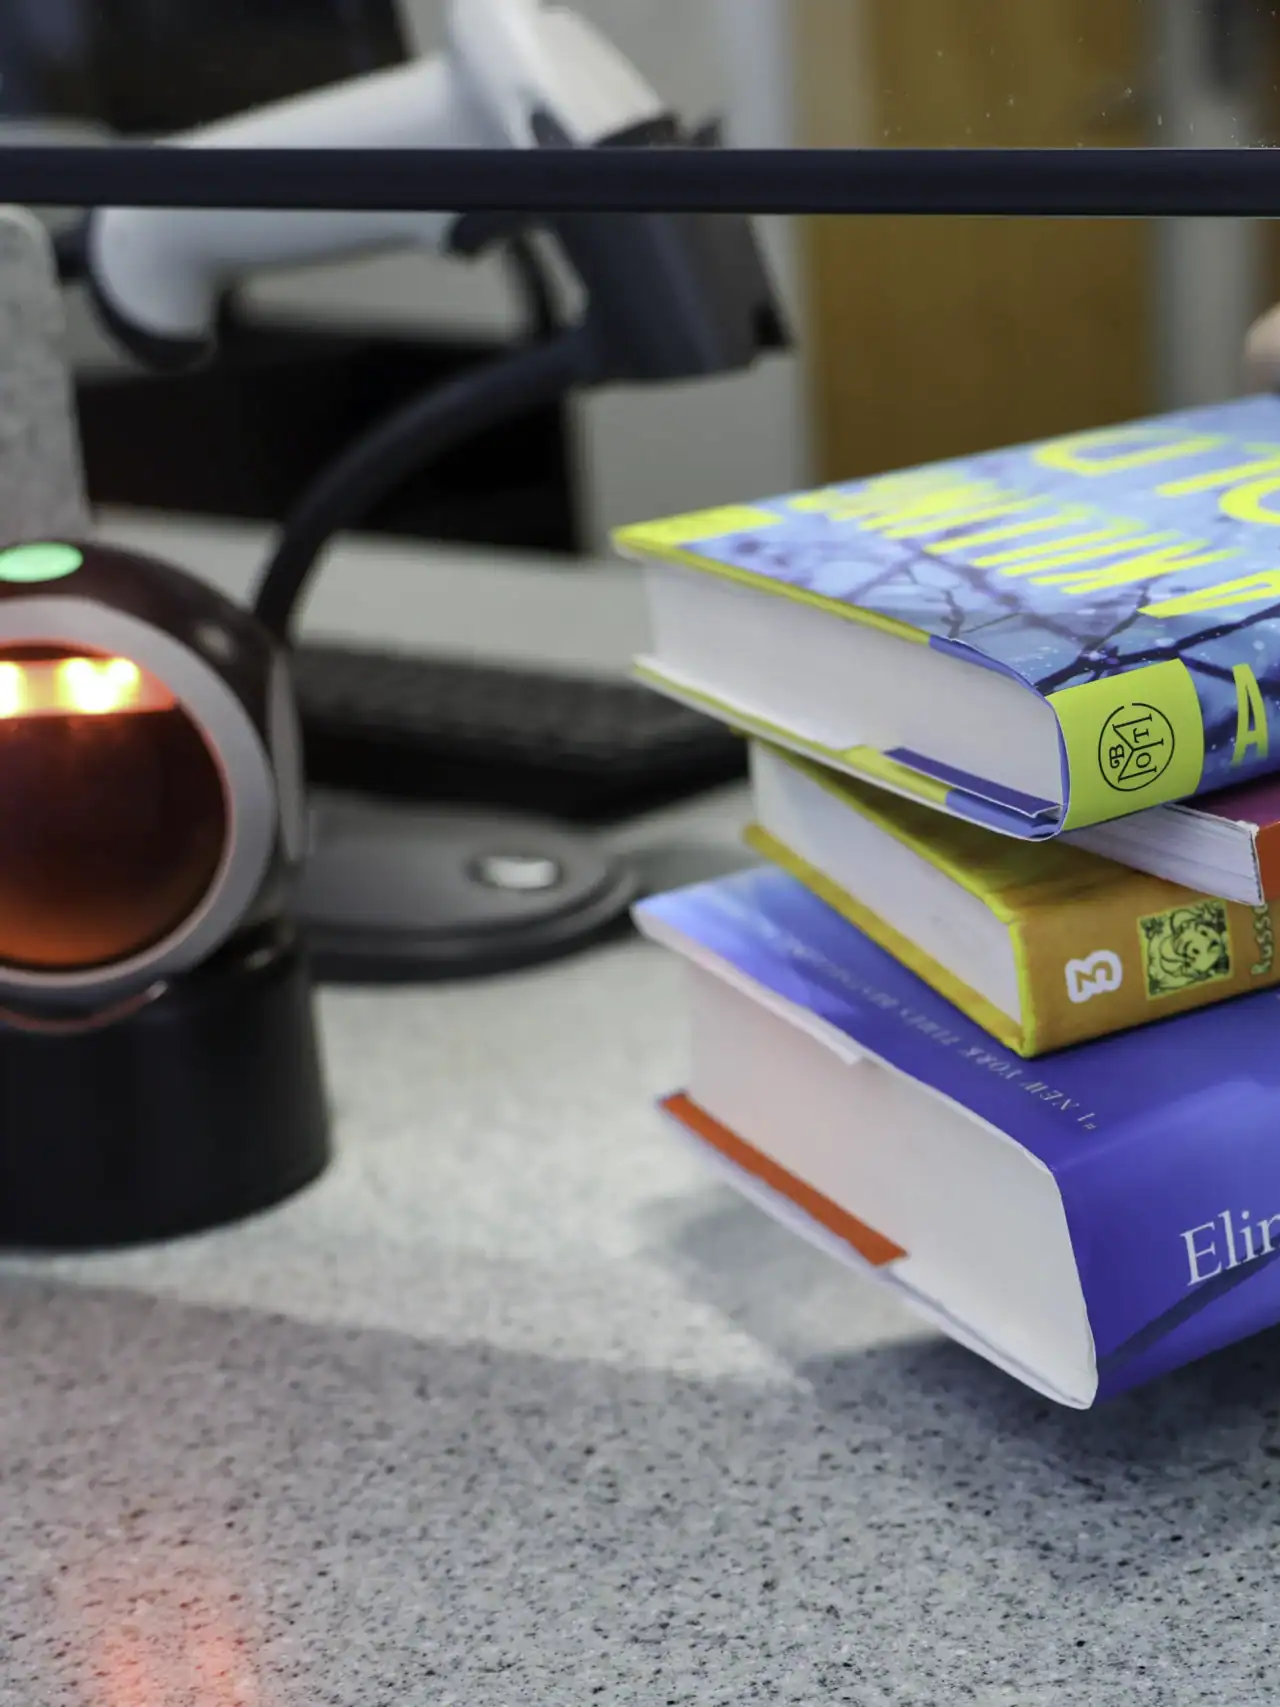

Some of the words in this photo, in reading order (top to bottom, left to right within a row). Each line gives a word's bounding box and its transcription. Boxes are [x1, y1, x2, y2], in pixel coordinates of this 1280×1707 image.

[1231, 662, 1268, 768] A
[1068, 953, 1120, 1000] 3
[964, 1046, 1022, 1080] YORK
[1020, 1081, 1080, 1112] NEW
